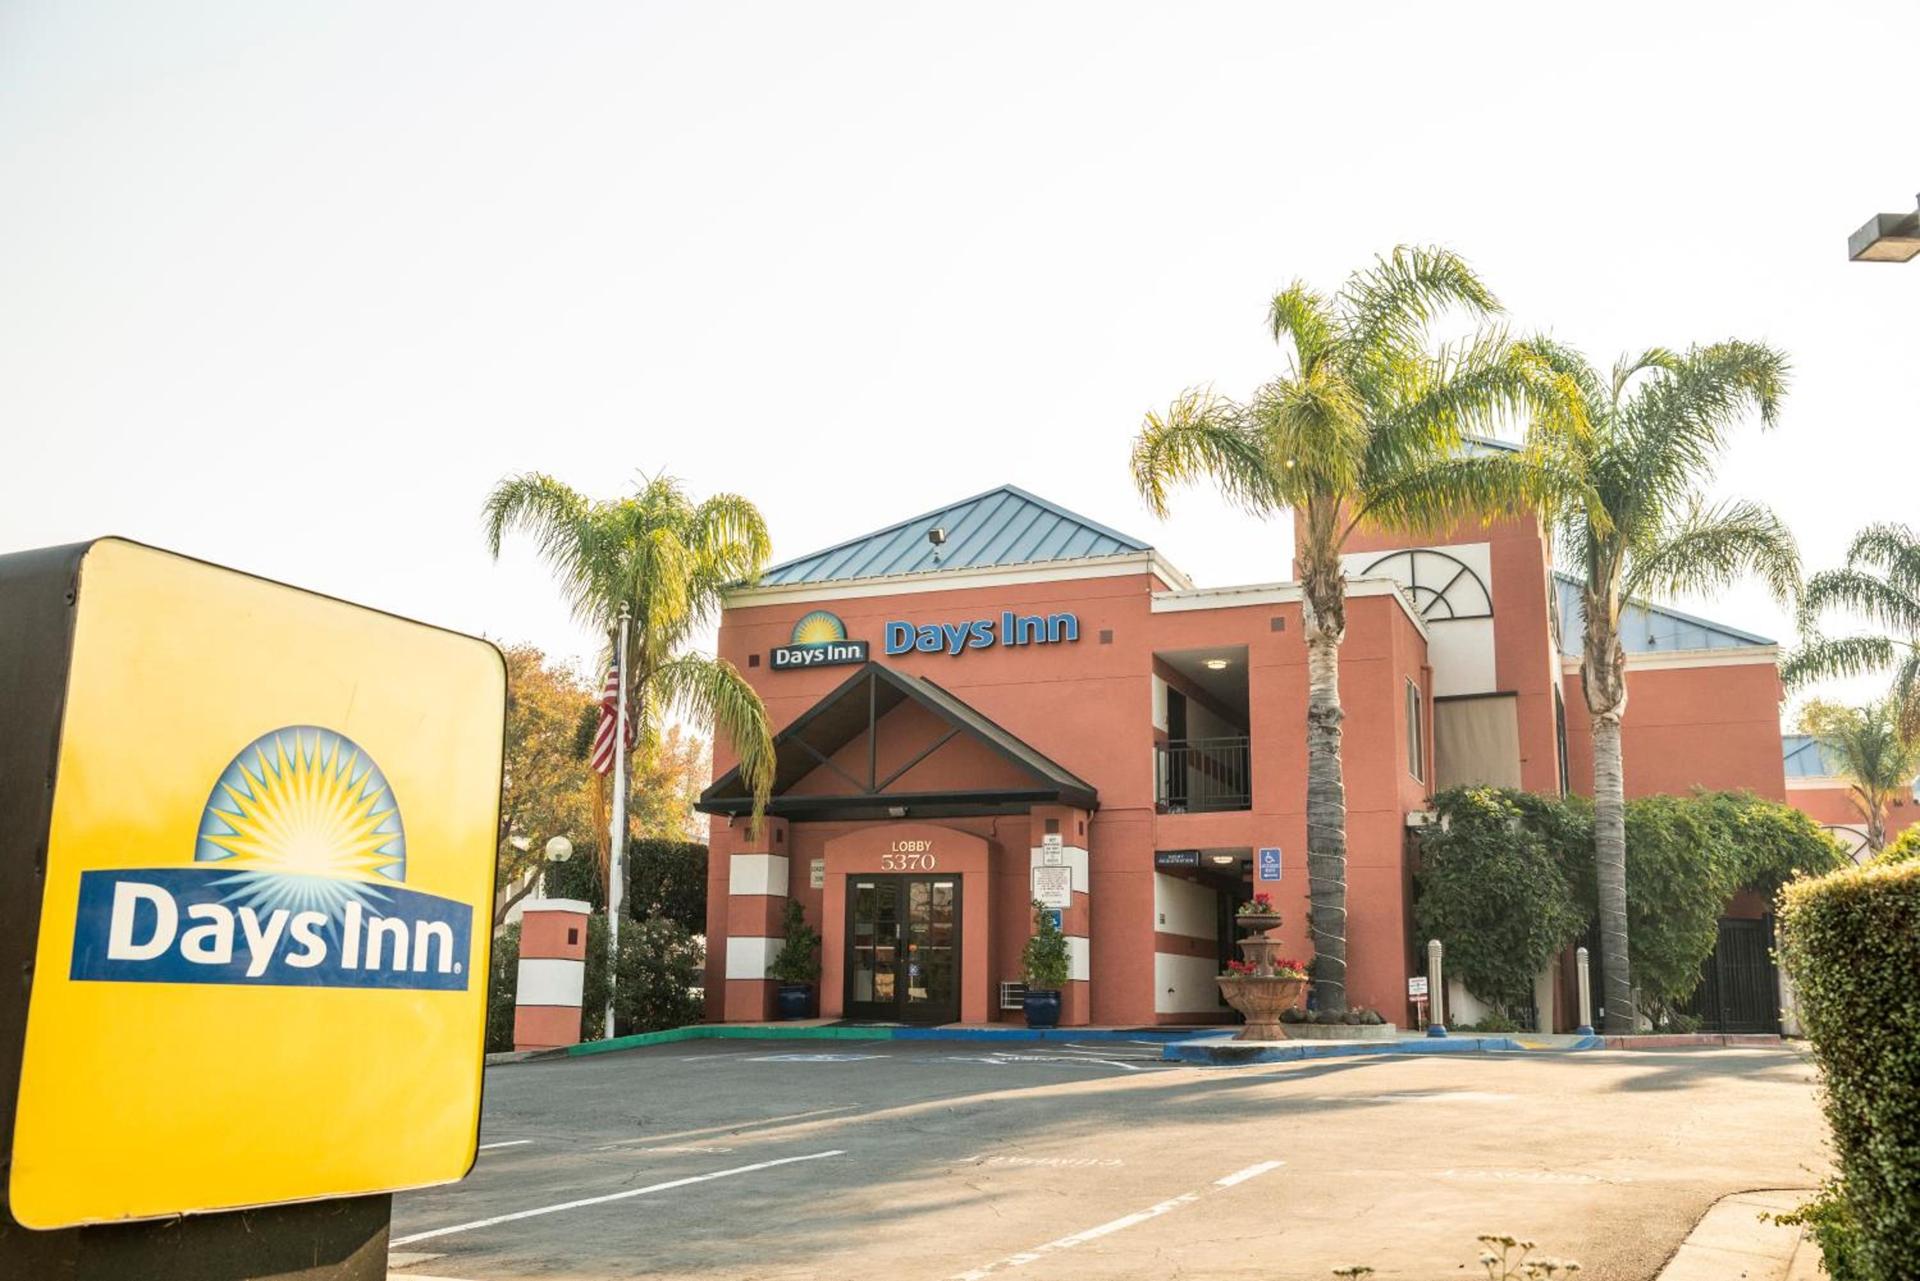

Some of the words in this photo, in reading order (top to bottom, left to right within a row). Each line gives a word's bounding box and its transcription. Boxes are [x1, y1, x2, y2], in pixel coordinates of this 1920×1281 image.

[885, 620, 996, 656] Days
[1001, 610, 1079, 646] Inn
[775, 647, 825, 665] Days
[827, 645, 861, 660] Inn
[892, 841, 932, 852] LOBBY
[881, 854, 936, 871] 5370
[107, 881, 329, 978] Days
[341, 901, 455, 974] Inn
